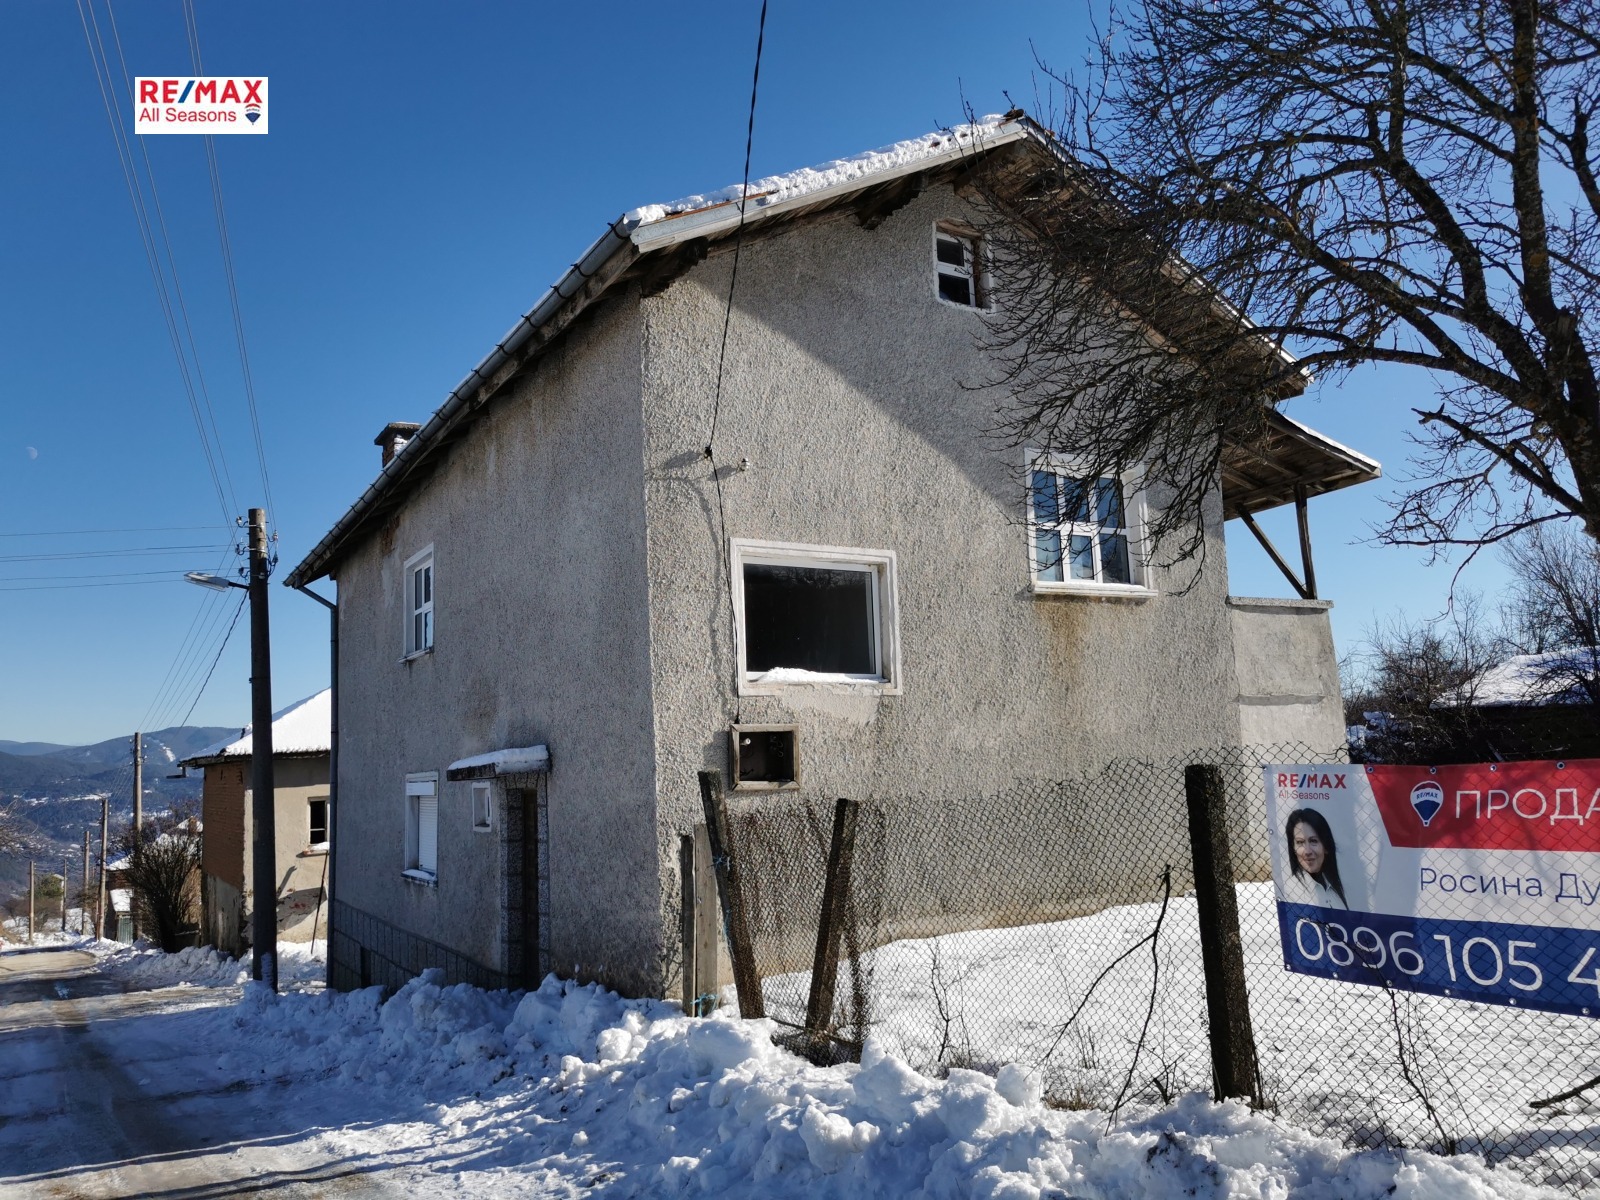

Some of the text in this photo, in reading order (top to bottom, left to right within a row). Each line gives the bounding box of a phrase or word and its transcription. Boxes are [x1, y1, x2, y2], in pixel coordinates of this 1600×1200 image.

[1277, 773, 1347, 789] RE/MAX
[1278, 789, 1330, 801] All Seasons
[1416, 791, 1438, 800] RE/MAX
[1420, 867, 1543, 898] Росина
[1295, 917, 1425, 976] 0896
[1433, 934, 1543, 991] 105
